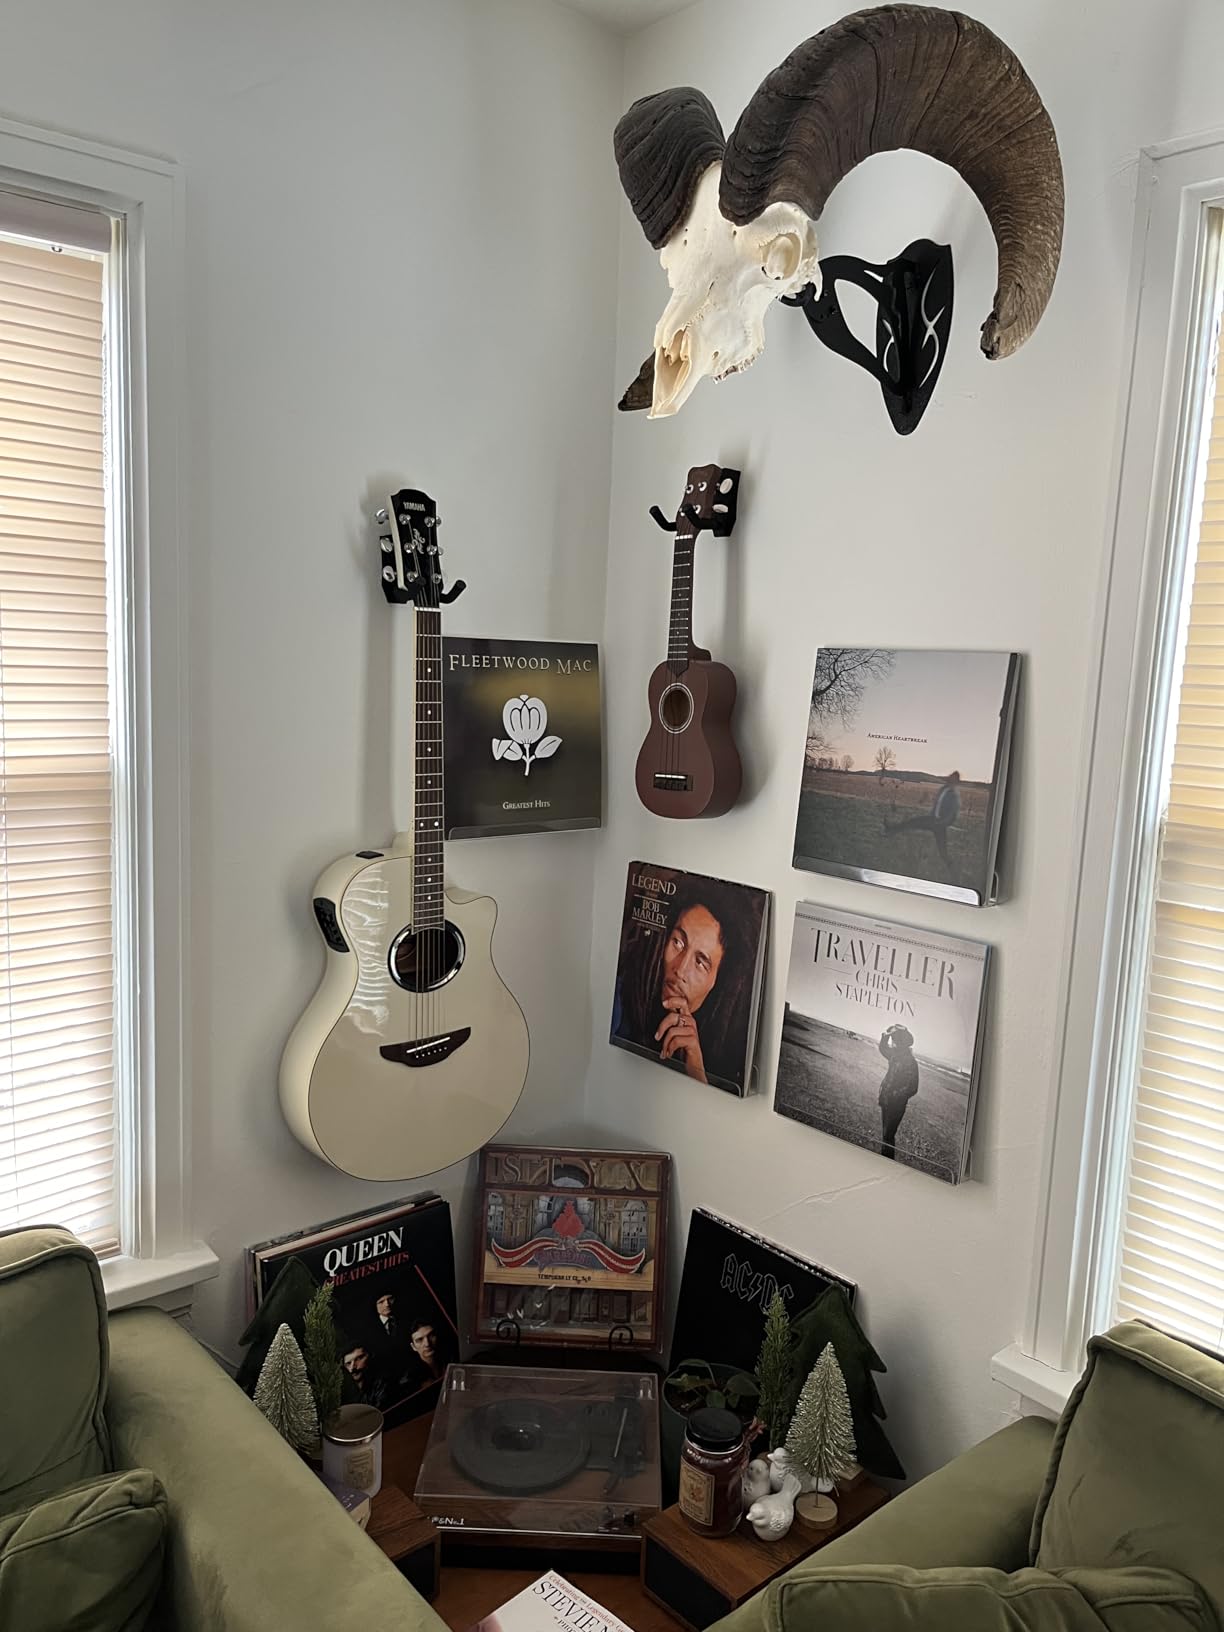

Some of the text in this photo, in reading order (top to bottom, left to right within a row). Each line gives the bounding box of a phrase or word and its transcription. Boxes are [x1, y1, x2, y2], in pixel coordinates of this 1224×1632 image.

[402, 501, 426, 512] YAMAHA
[448, 653, 593, 676] FLEETWOOD MAC
[502, 798, 551, 810] GREATEST HITS
[631, 873, 677, 896] LEGEND
[632, 907, 667, 925] MARLEY
[642, 899, 660, 913] BOB
[810, 927, 956, 1001] TRAVELLER
[855, 969, 899, 994] CHRIS
[834, 982, 917, 1018] STAPLETON
[323, 1226, 404, 1277] QUEEN
[383, 1251, 410, 1269] HITS
[532, 1580, 600, 1632] STEVIE
[549, 1575, 580, 1602] Celebrating
[585, 1603, 615, 1628] Legendary
